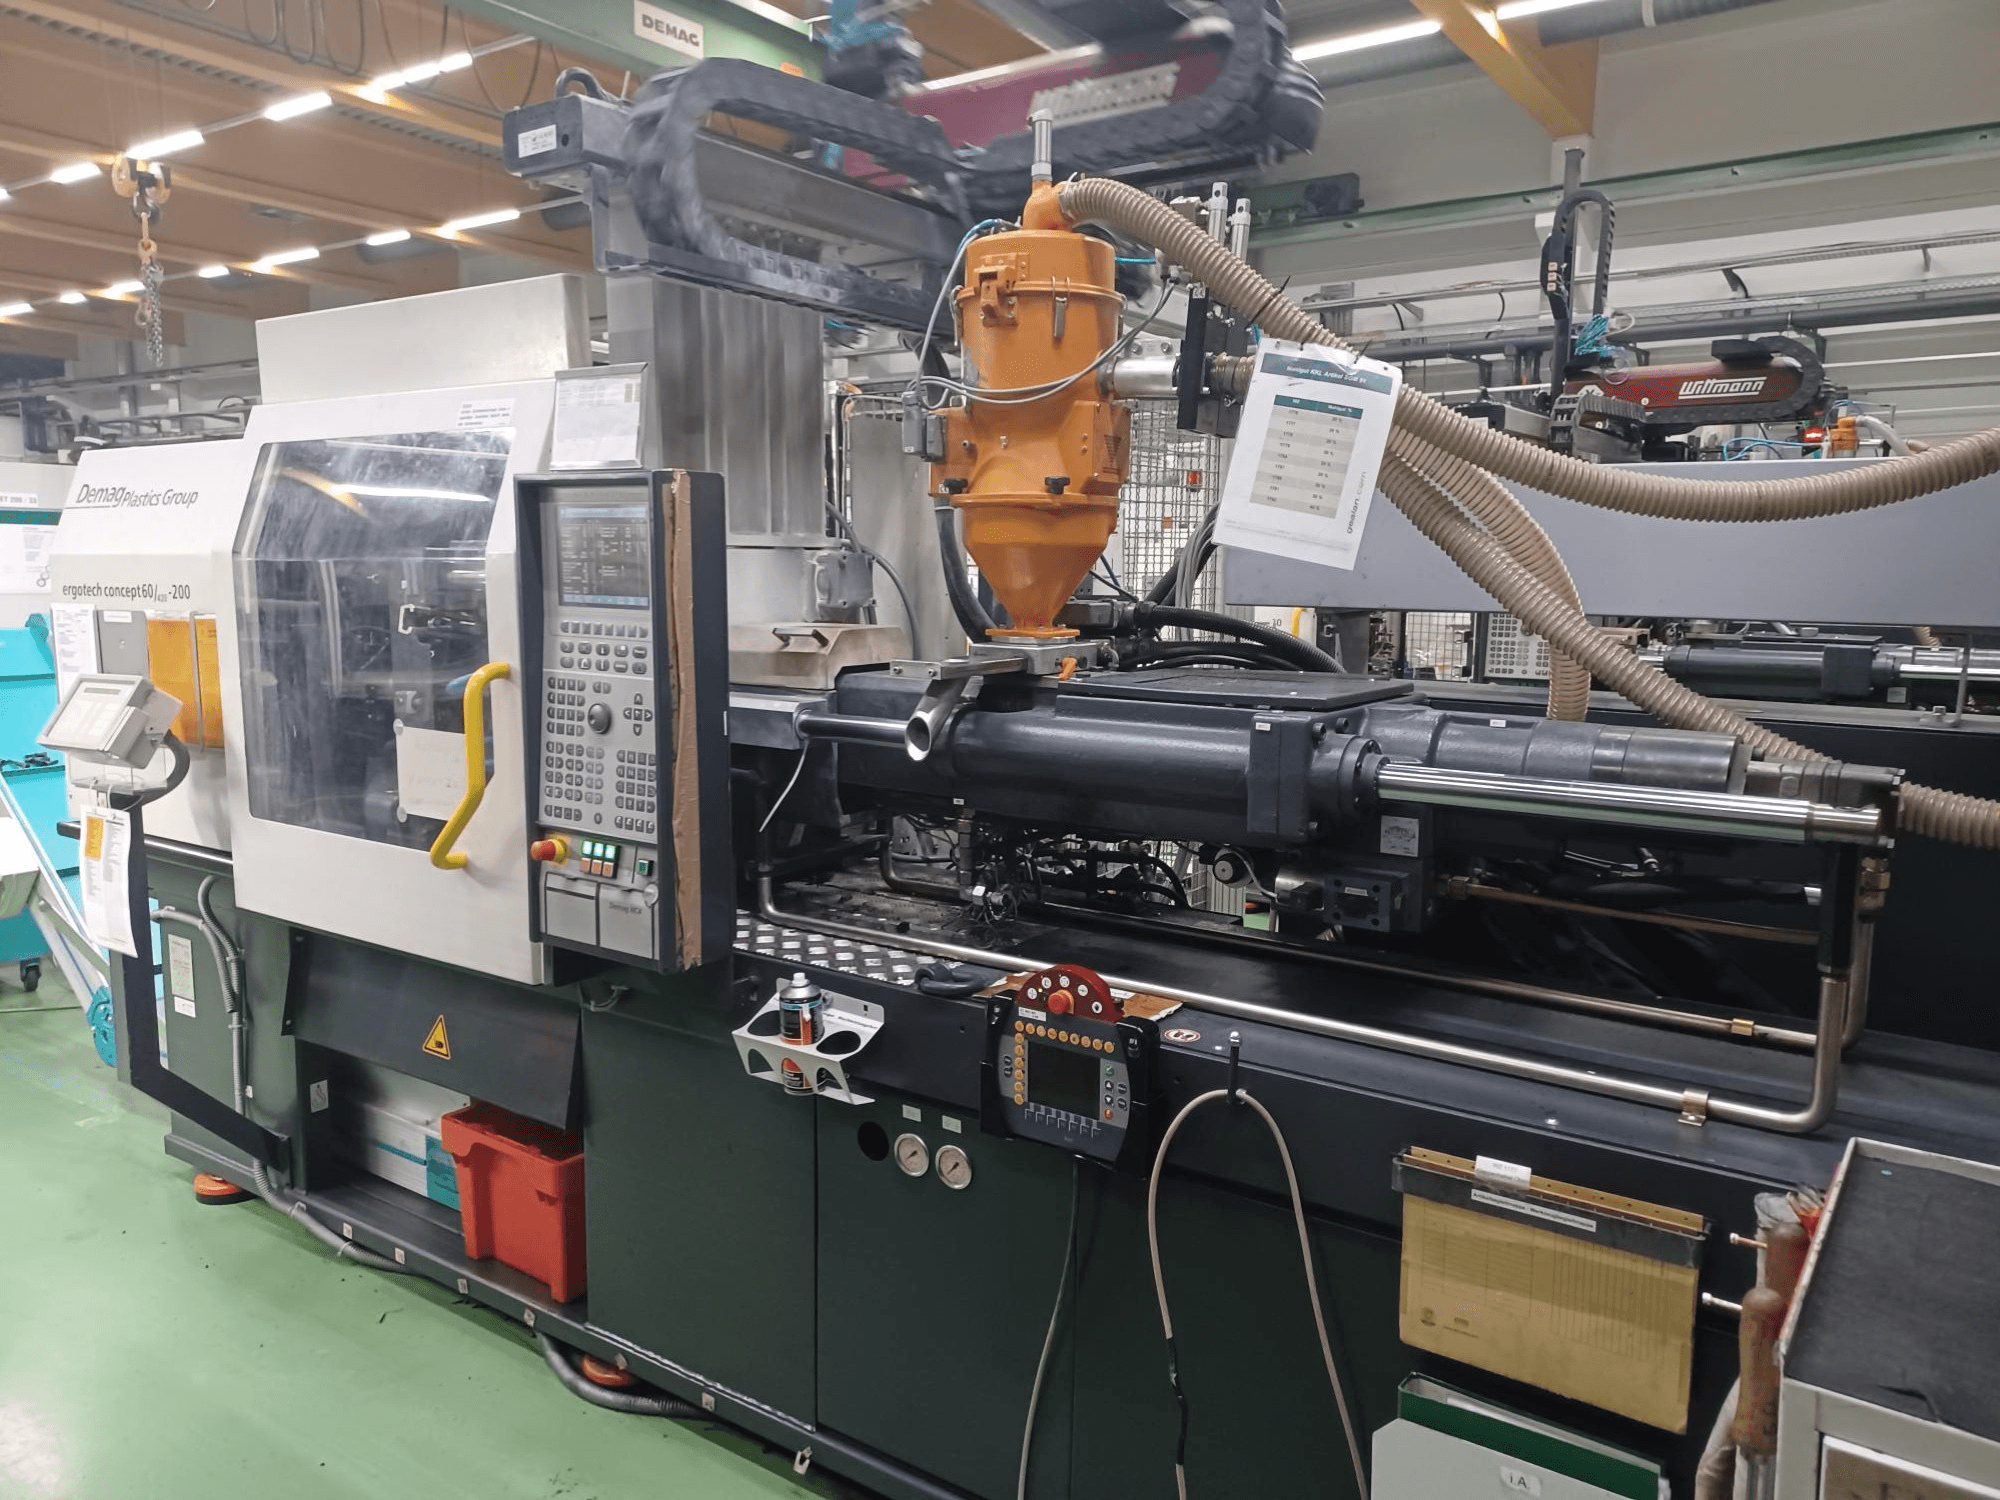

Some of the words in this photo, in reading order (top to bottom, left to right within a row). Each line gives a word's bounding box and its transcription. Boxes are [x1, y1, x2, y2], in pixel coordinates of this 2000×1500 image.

[642, 13, 700, 47] DEMAG
[1679, 378, 1766, 396] Wittmann
[162, 488, 199, 509] Group
[62, 582, 102, 600] ergotech
